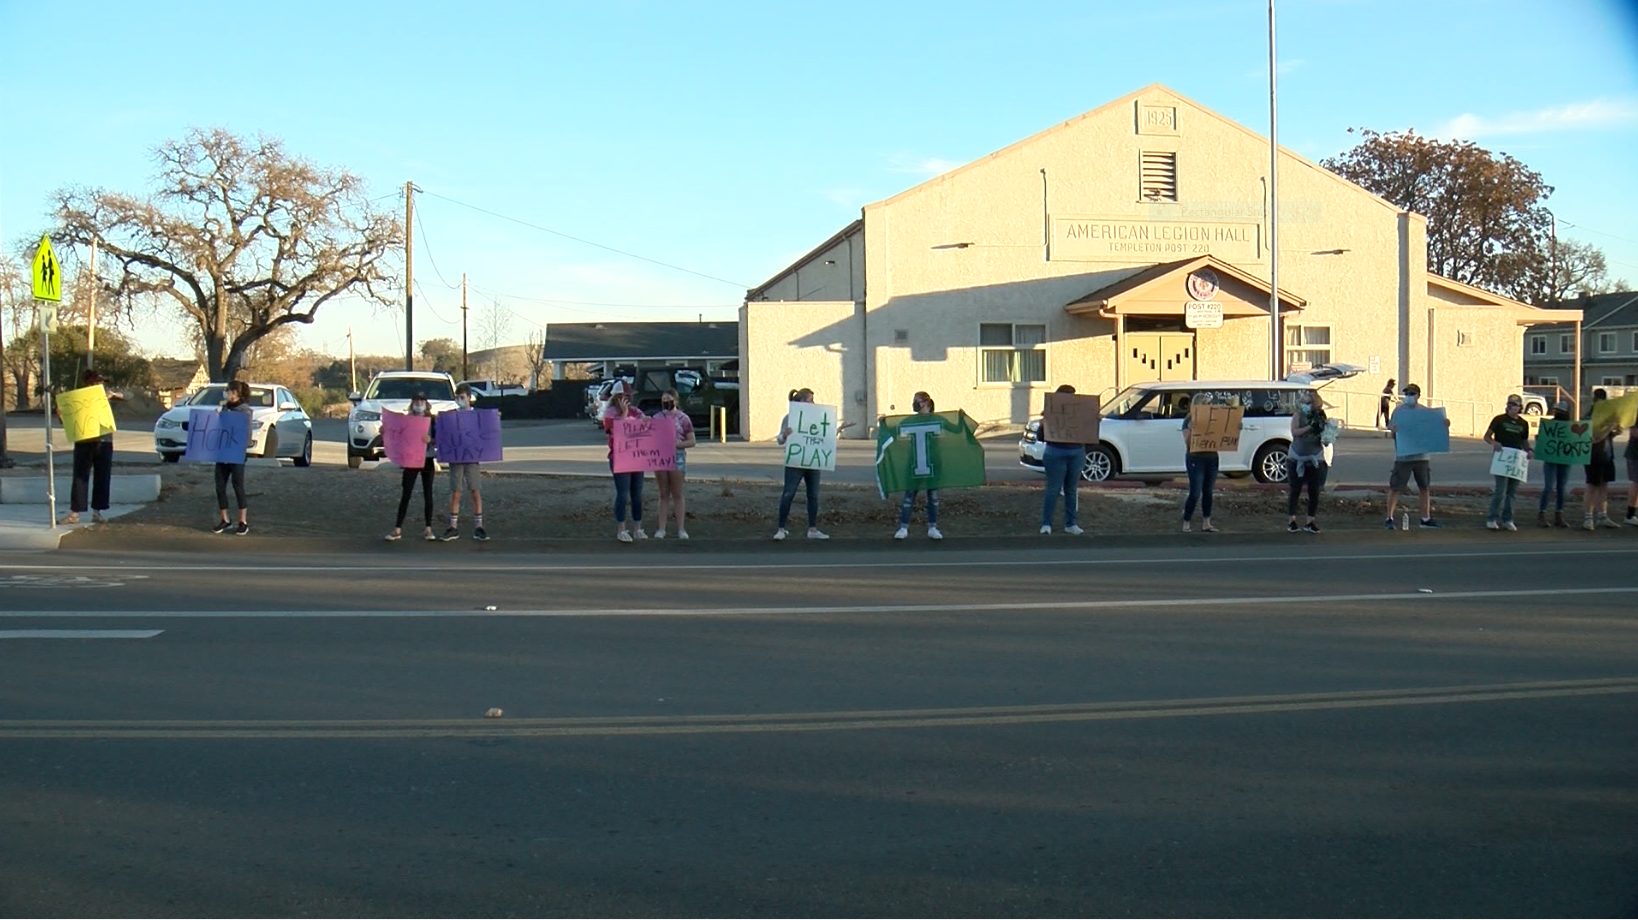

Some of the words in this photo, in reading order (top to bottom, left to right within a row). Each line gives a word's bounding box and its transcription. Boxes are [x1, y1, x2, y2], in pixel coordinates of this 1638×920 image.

[1066, 223, 1149, 240] AMERICAN
[1153, 225, 1210, 241] LEGION
[1215, 227, 1250, 242] HALL
[1108, 242, 1162, 252] TEMPLETON
[1164, 243, 1188, 253] POST
[1192, 243, 1210, 253] 220
[797, 410, 830, 438] Let
[1193, 406, 1238, 436] LET
[1542, 422, 1567, 438] WE
[786, 443, 833, 468] PLAY
[897, 421, 944, 478] T
[1545, 437, 1592, 457] SPORTS
